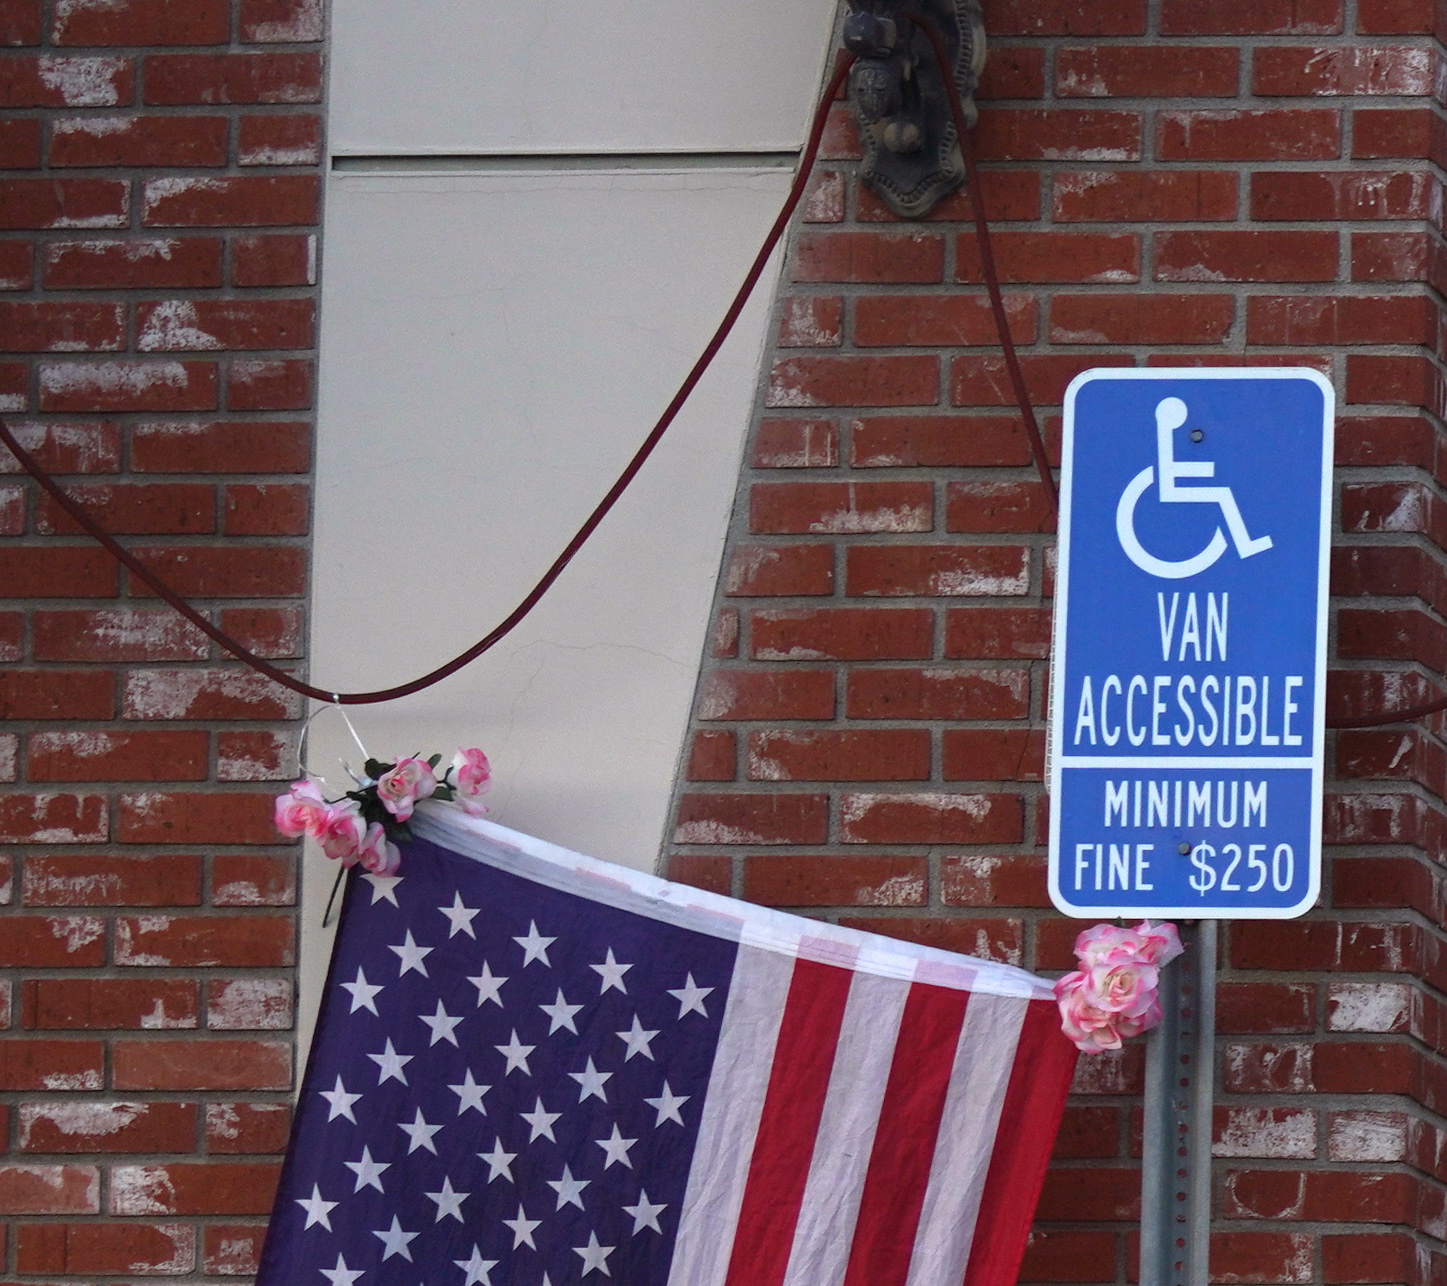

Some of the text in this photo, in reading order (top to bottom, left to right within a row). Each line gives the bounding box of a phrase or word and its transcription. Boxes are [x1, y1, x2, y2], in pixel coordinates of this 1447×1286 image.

[1157, 591, 1229, 662] VAN
[1073, 674, 1303, 747] ACCESSIBLE
[1104, 780, 1268, 829] MINIMUM
[1074, 839, 1295, 897] FINE $250
